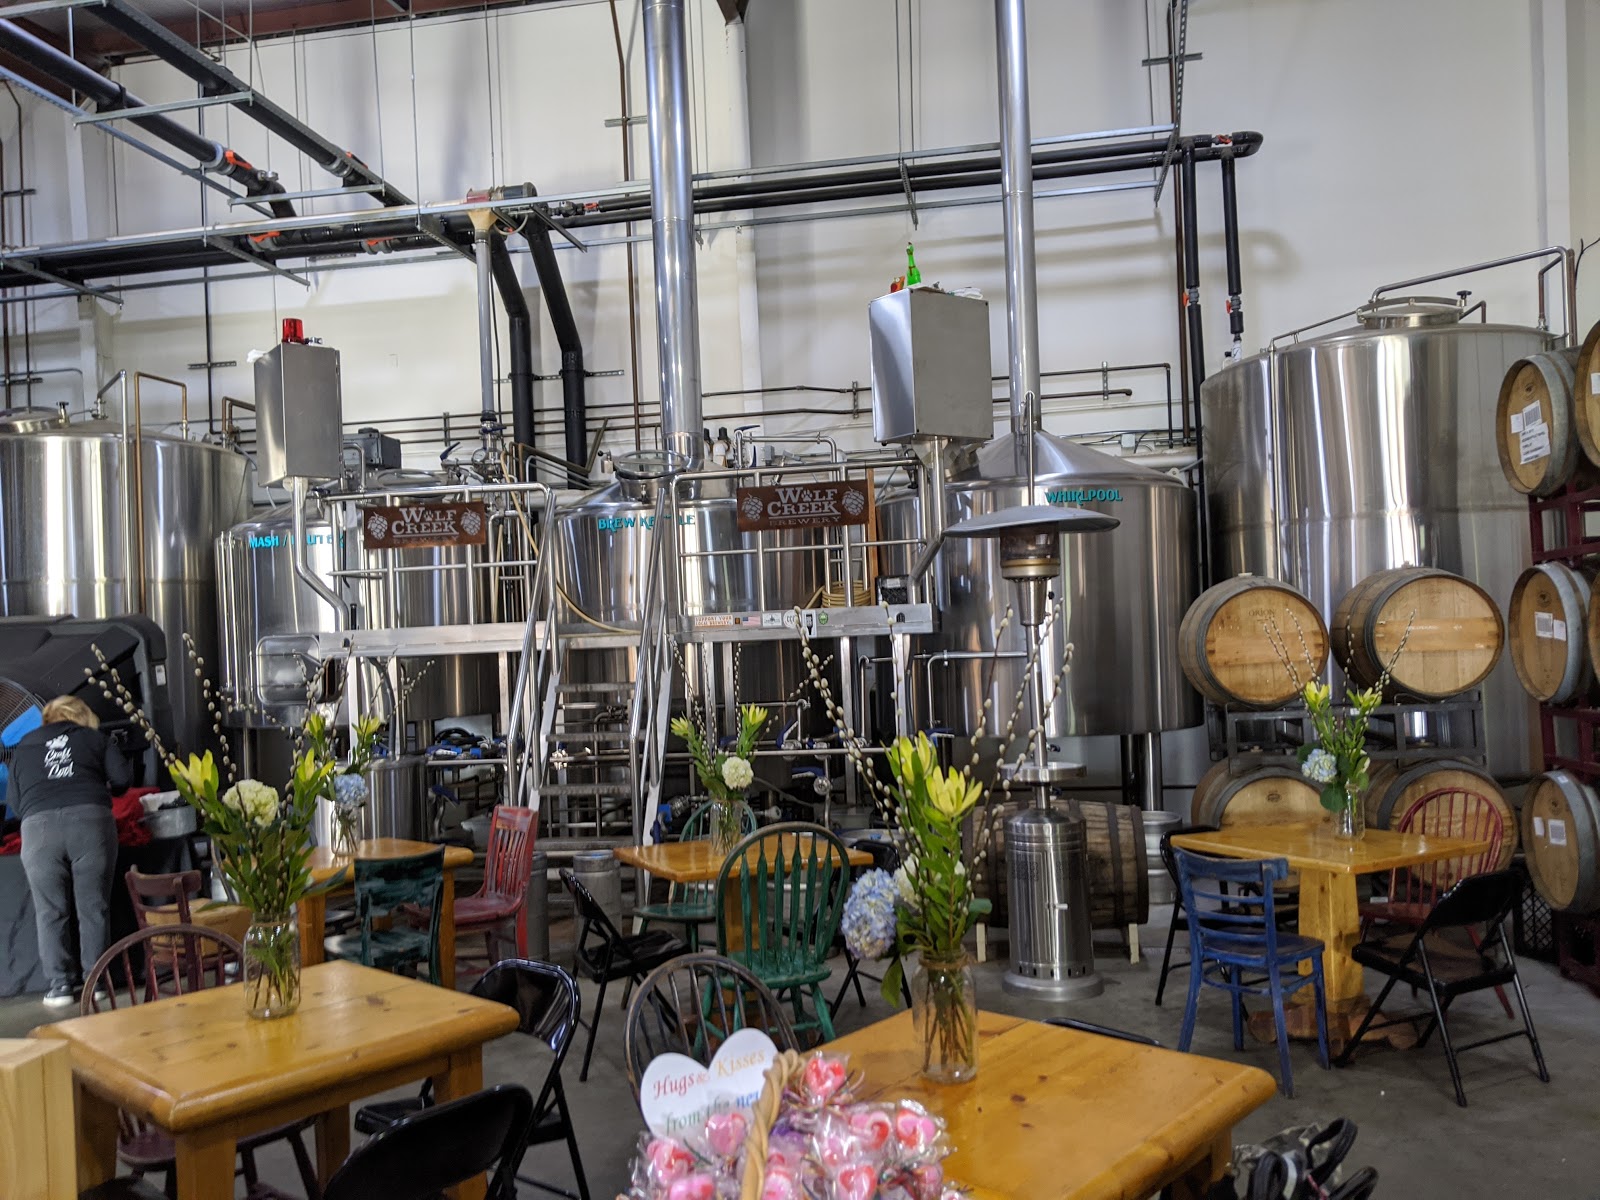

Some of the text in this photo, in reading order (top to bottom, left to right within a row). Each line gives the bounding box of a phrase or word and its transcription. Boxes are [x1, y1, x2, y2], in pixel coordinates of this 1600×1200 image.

[1044, 489, 1123, 506] WHIRLPOOL
[767, 501, 841, 516] CREEK
[391, 521, 459, 535] CREEK
[598, 514, 696, 532] BREW KELE
[769, 516, 841, 526] BREWERY
[248, 535, 279, 548] MASH
[653, 1072, 695, 1100] Hugs
[715, 1049, 765, 1079] Kisses
[665, 1108, 700, 1135] from
[705, 1095, 730, 1117] the
